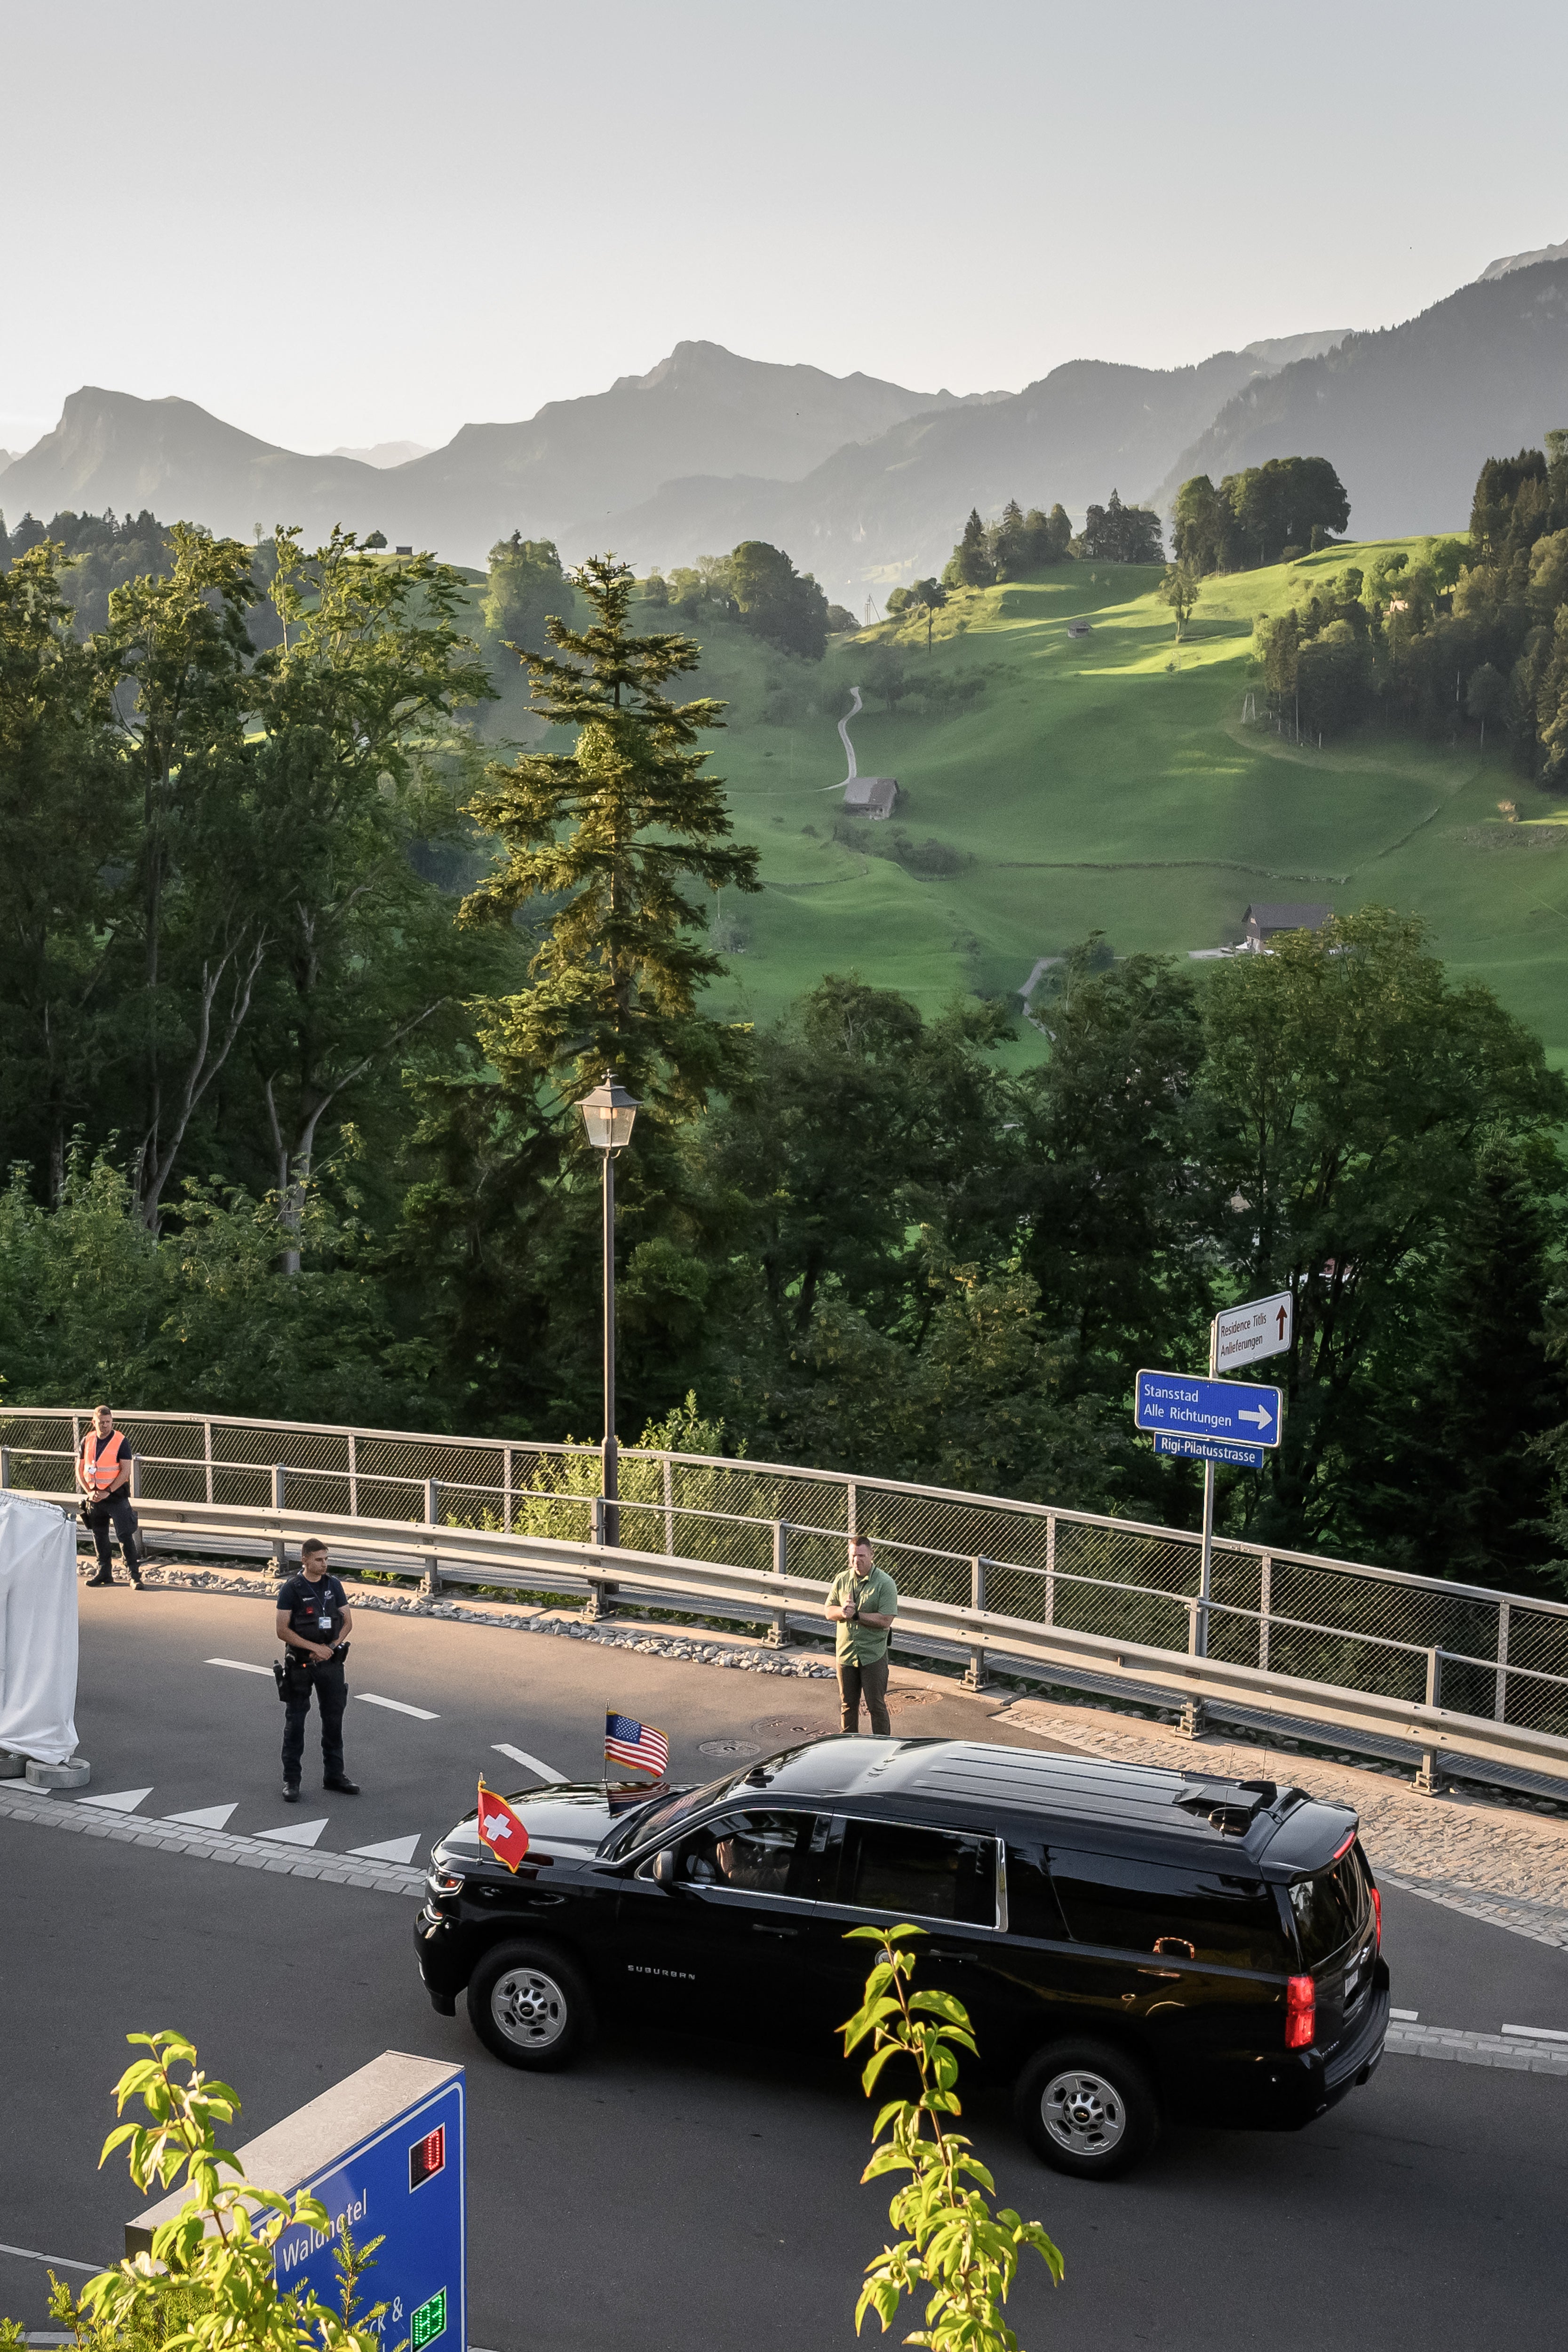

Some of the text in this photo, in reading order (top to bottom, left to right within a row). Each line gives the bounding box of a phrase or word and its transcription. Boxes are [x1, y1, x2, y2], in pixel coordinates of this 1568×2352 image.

[1221, 1312, 1267, 1337] Residence Titlis
[1220, 1335, 1263, 1357] Anlieferungen
[1144, 1384, 1199, 1403] Stansstad
[1144, 1403, 1232, 1428] Alle Richtungen
[1161, 1437, 1256, 1463] Rigi-Pilatusstrasse
[628, 1965, 695, 1980] SUBURBAN
[392, 2296, 403, 2322] &
